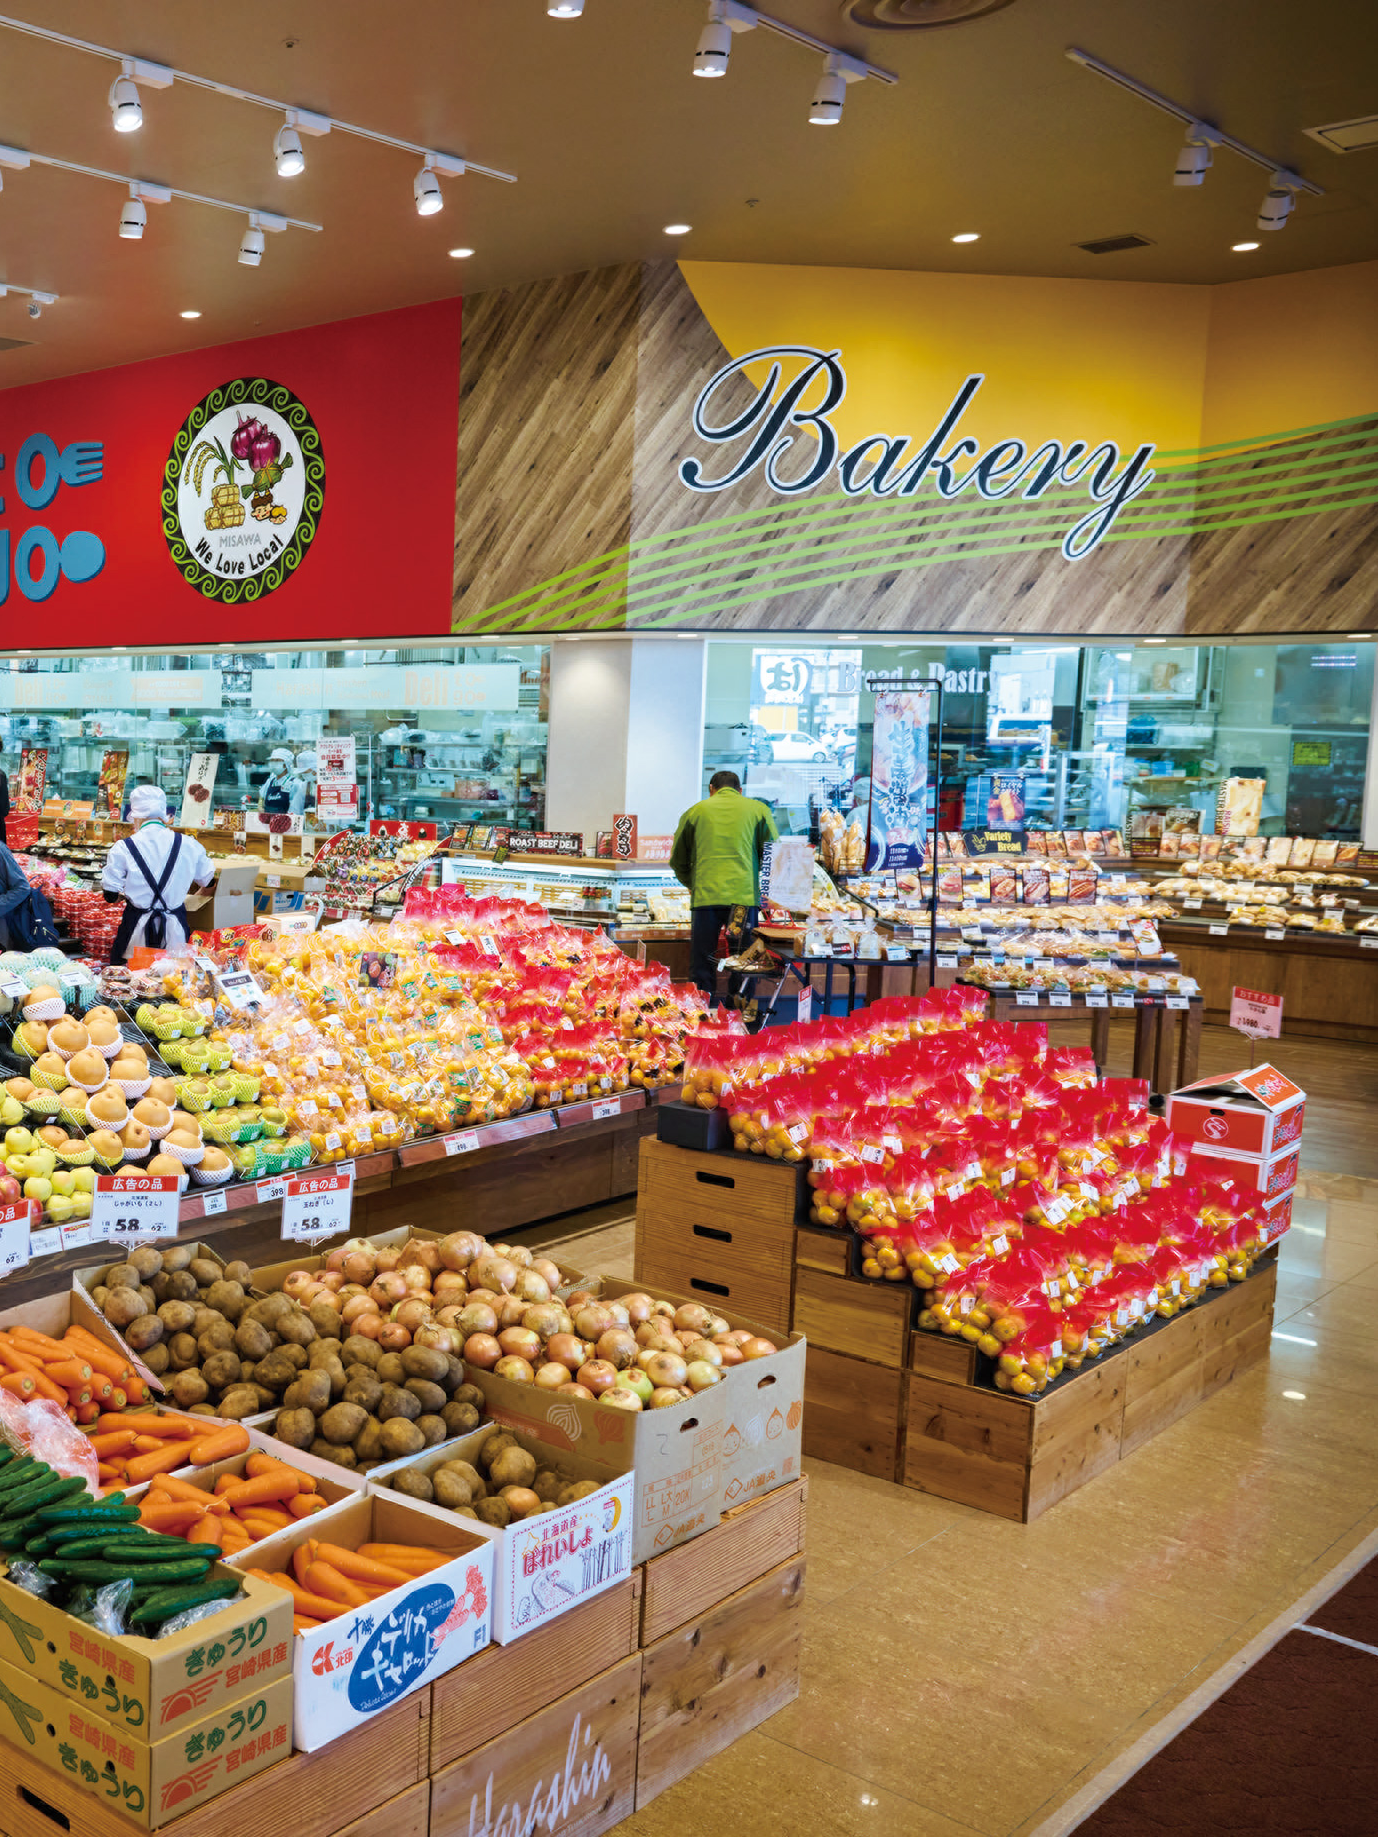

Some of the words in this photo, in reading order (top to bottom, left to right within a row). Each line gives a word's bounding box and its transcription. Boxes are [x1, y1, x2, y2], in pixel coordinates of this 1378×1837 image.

[679, 345, 1157, 562] Bakery
[195, 537, 212, 564] We
[215, 553, 245, 574] Love
[248, 533, 284, 571] Local
[219, 533, 262, 547] MISAWA
[275, 680, 333, 697] Harashin
[405, 671, 448, 705] Deli
[509, 837, 538, 850] ROAST
[539, 838, 559, 850] BEEF
[560, 839, 578, 850] DELI
[984, 831, 1012, 843] Variety
[997, 841, 1022, 852] Bread
[761, 841, 773, 877] MASTER
[112, 1178, 163, 1190] 広告の品
[270, 1187, 284, 1197] 398
[299, 1177, 338, 1193] 広告の品
[114, 1218, 140, 1232] 58
[301, 1217, 320, 1231] 58
[5, 1255, 15, 1264] 62
[645, 1495, 656, 1510] LL
[541, 1514, 579, 1541] 北海道産
[522, 1525, 594, 1578] ばれいしょ
[184, 1616, 268, 1678] きゅうり
[382, 1607, 428, 1654] デリカ
[68, 1630, 136, 1686] 宮崎県産
[225, 1641, 288, 1689] 宮崎県産
[335, 1649, 353, 1670] 北印
[58, 1658, 145, 1727] きゅうり
[68, 1712, 136, 1771] 宮崎県産
[184, 1699, 268, 1764] きゅうり
[225, 1723, 288, 1774] 宮崎県産
[58, 1742, 145, 1813] きゅうり
[468, 1712, 612, 1836] Harashin
